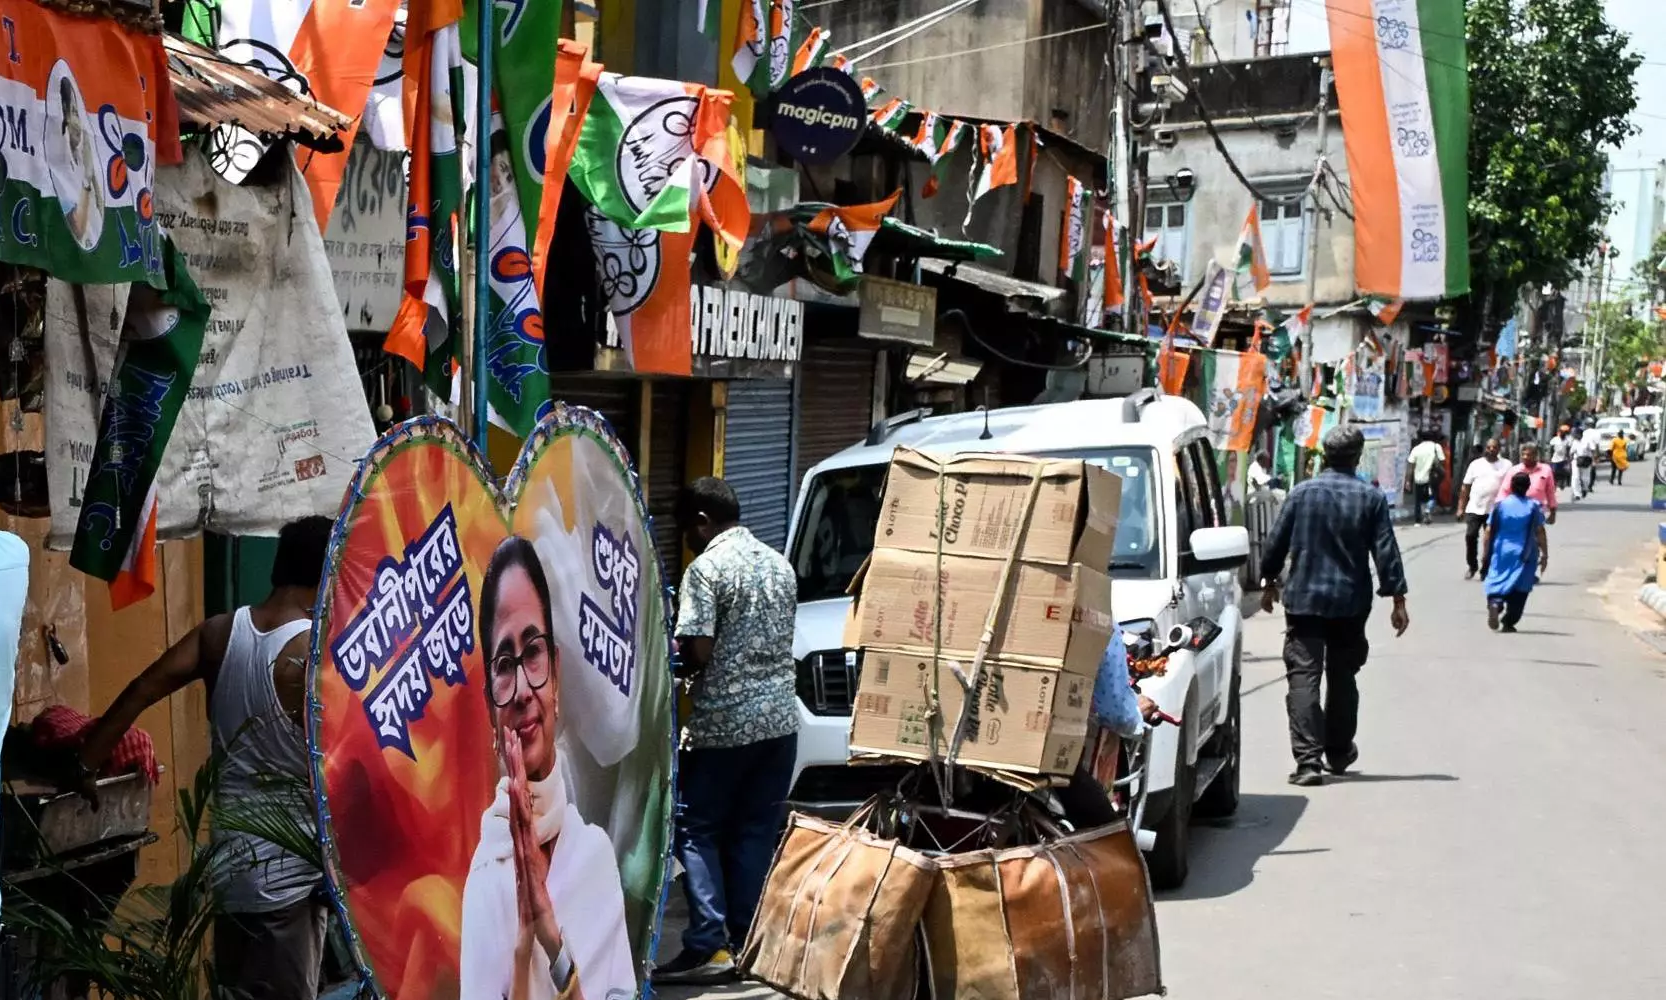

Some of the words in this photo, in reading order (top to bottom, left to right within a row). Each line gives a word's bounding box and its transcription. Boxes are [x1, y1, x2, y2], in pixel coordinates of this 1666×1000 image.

[5, 105, 35, 156] M.
[777, 102, 858, 130] magicpin
[11, 197, 38, 247] C.
[158, 213, 176, 229] 202
[943, 498, 966, 545] Choco
[337, 516, 458, 681] ভবানীপুরের
[594, 532, 638, 619] শুধুই
[370, 647, 429, 740] হৃদয়
[422, 587, 472, 676] জুড়ে
[581, 602, 632, 686] মমতা
